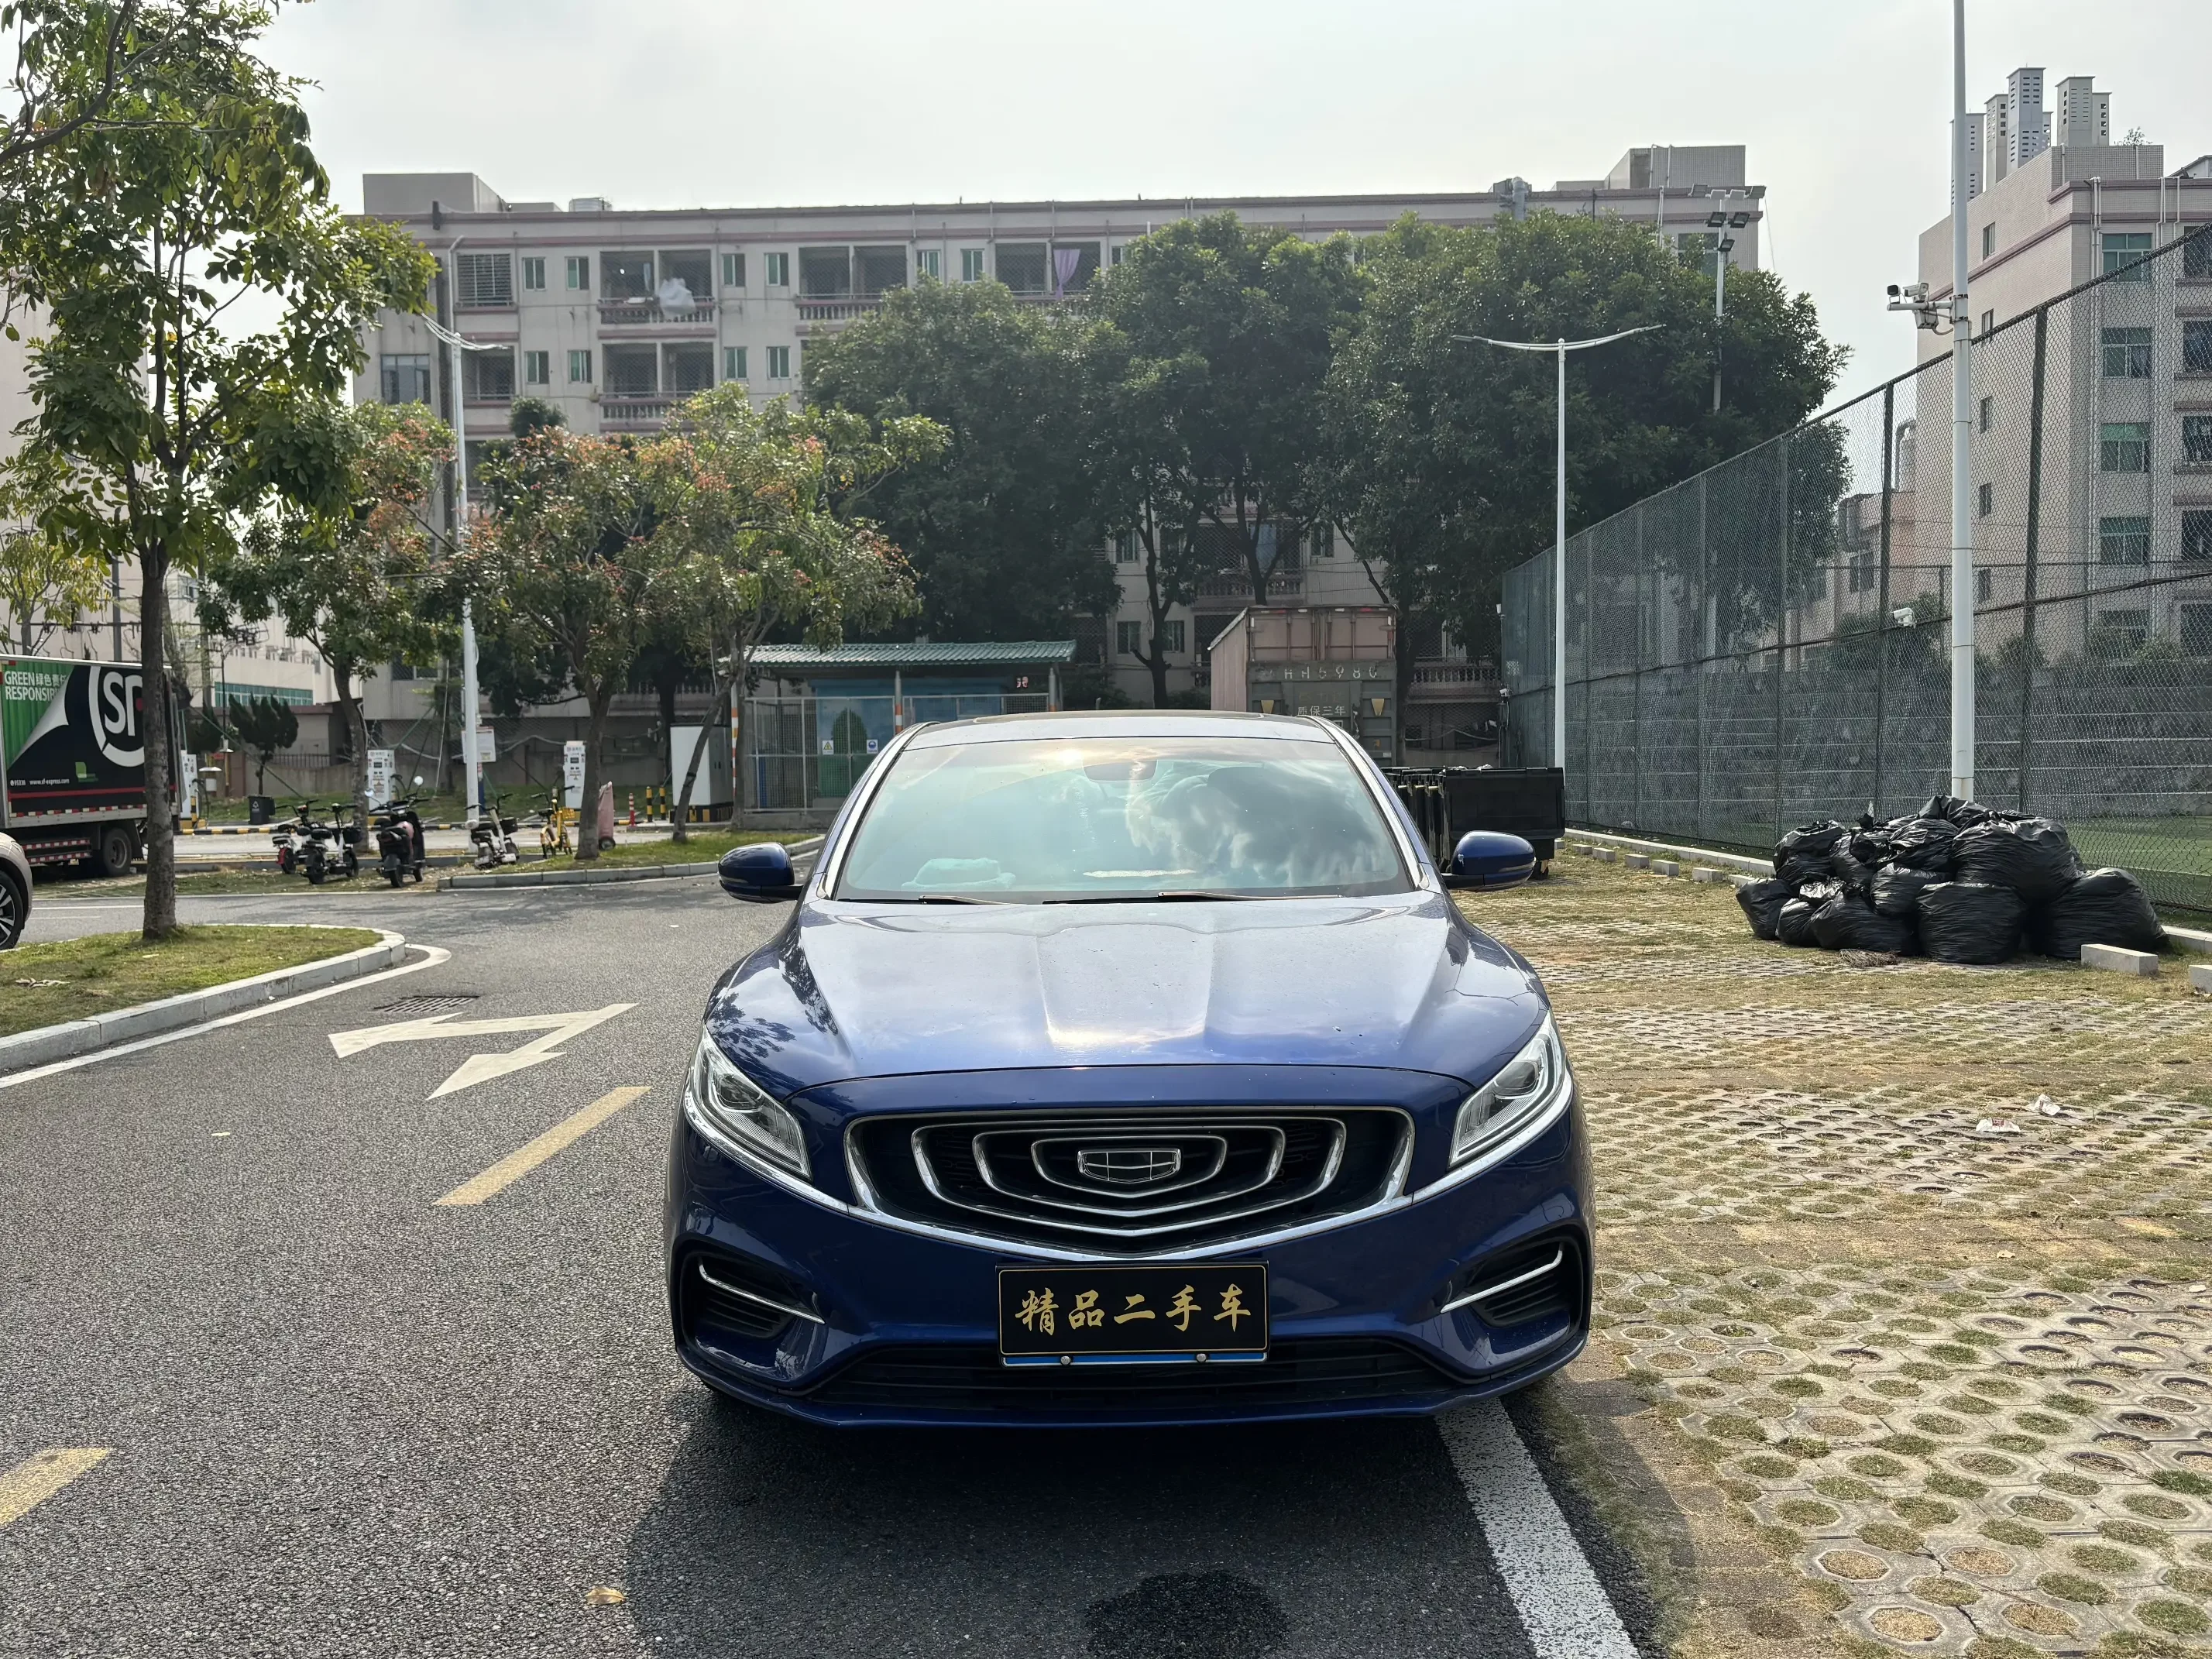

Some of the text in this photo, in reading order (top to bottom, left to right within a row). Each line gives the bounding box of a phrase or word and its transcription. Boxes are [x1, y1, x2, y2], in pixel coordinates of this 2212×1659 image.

[5, 671, 35, 686] GREEN
[1297, 705, 1346, 717] 质保三年
[1015, 1283, 1251, 1335] 精品二手车
